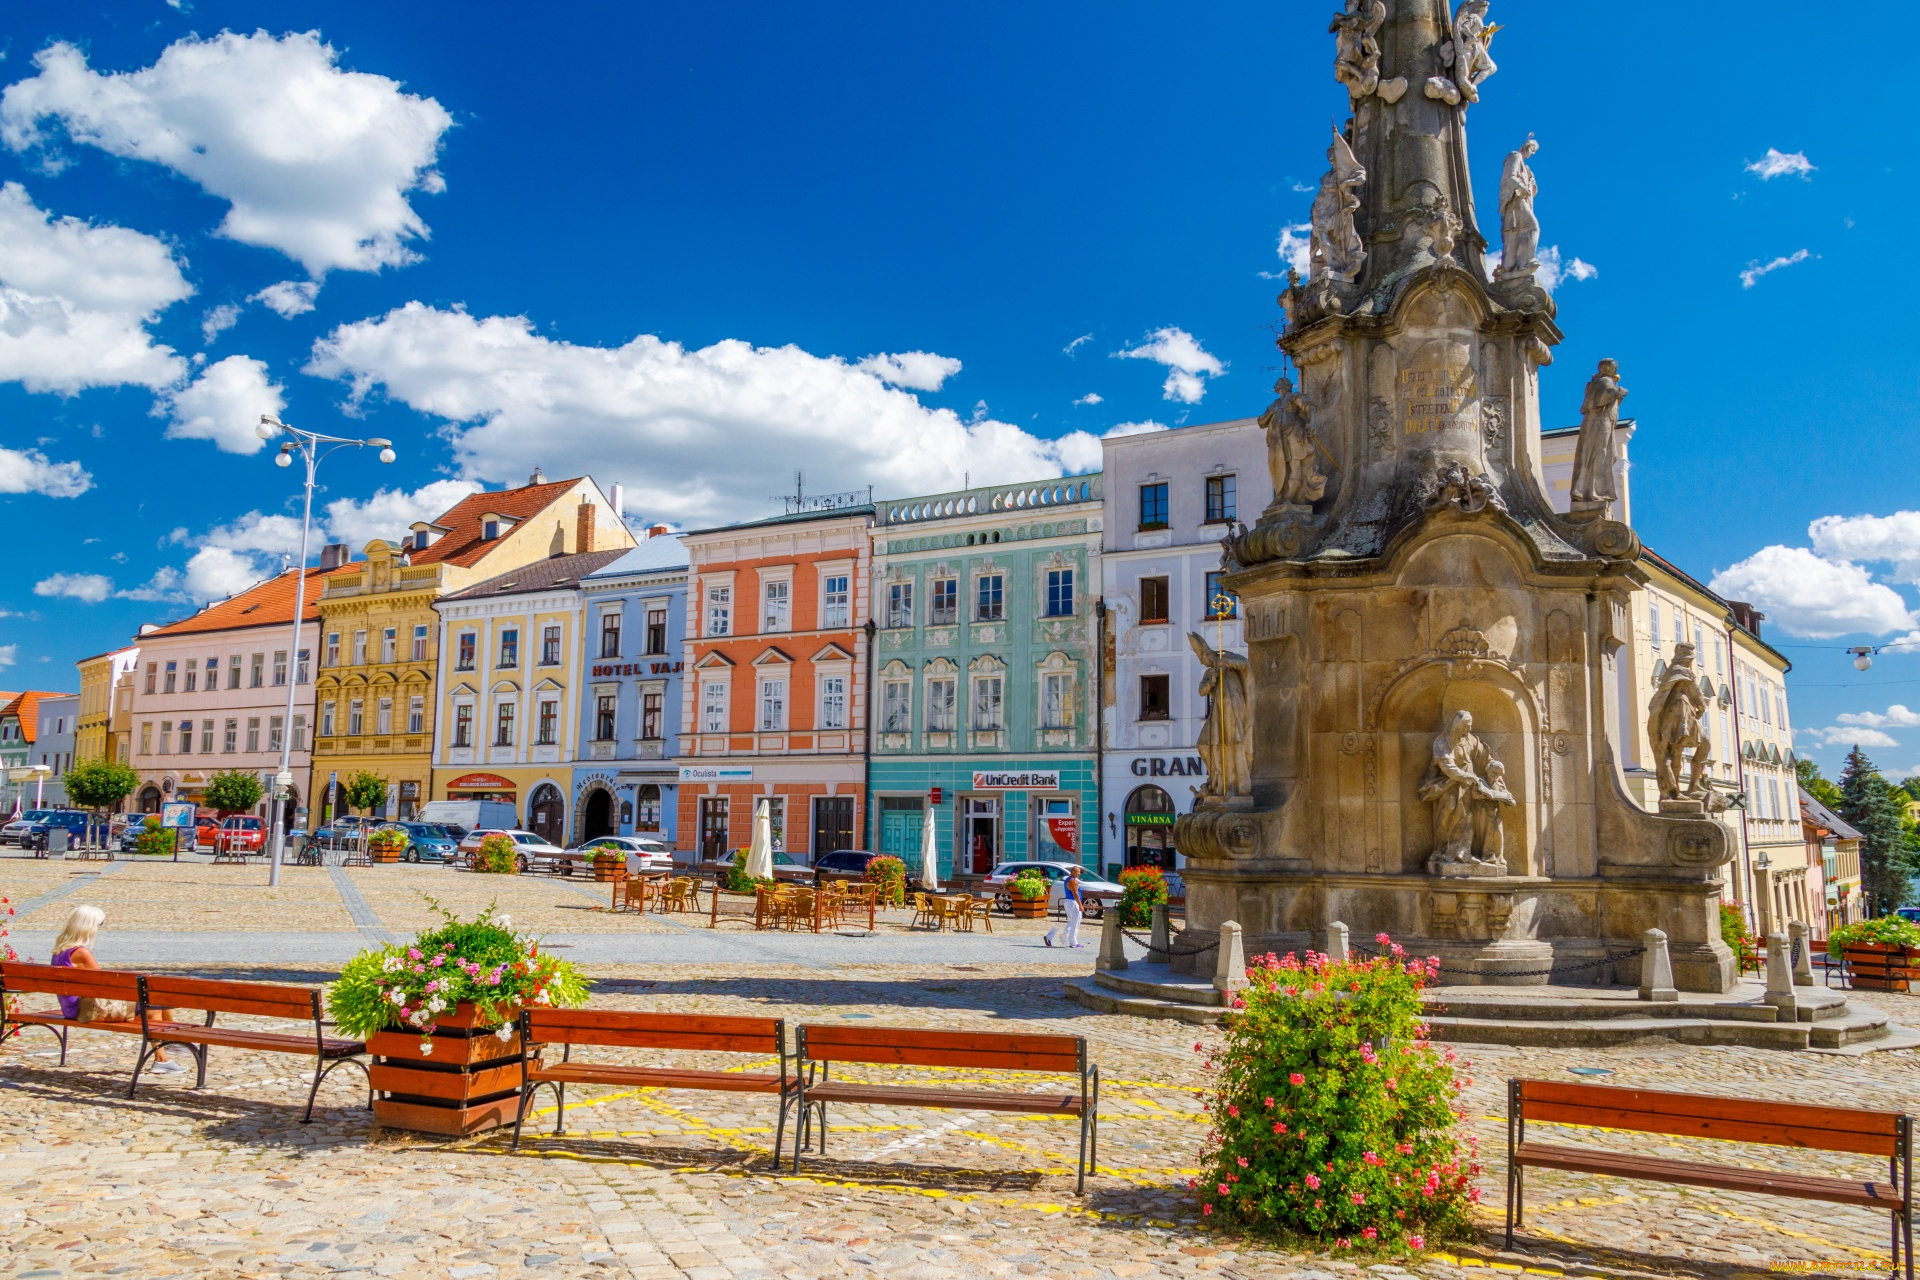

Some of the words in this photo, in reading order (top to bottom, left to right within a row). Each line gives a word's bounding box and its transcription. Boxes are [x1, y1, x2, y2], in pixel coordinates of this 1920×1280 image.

[592, 664, 642, 677] HOTEL
[1131, 757, 1209, 776] GRAN
[693, 769, 717, 778] Oculista
[576, 773, 620, 791] Restaurace
[986, 774, 1029, 786] UniCredit
[1031, 774, 1057, 785] Bank
[1131, 815, 1171, 824] VINÁRNA
